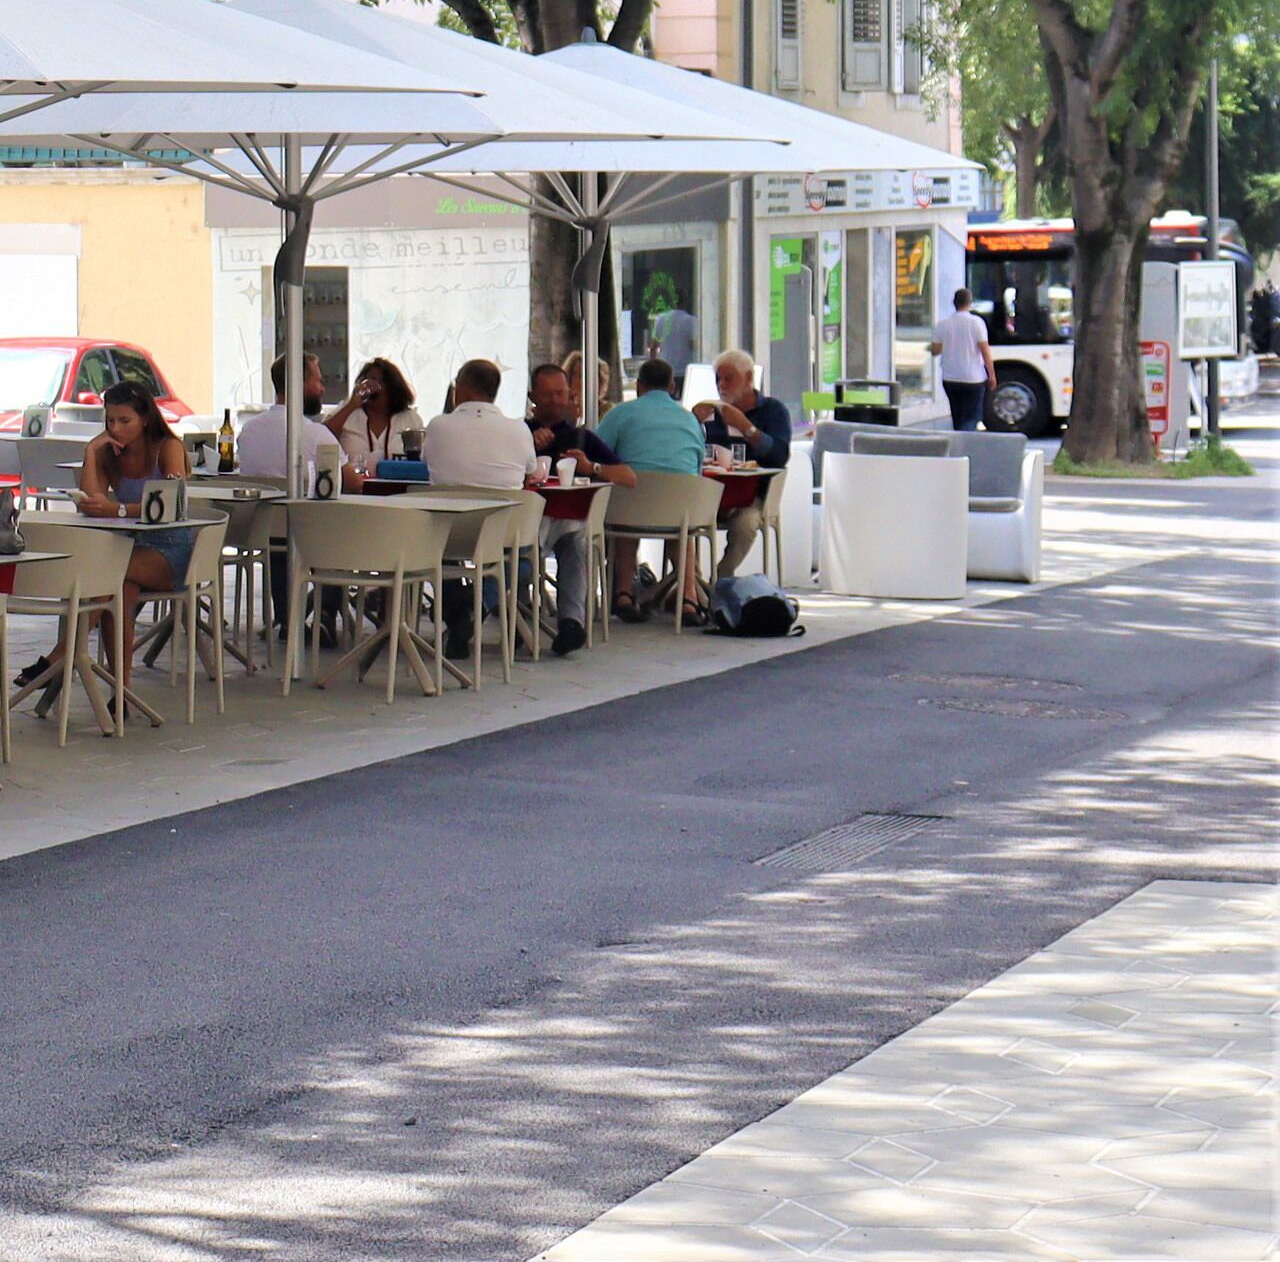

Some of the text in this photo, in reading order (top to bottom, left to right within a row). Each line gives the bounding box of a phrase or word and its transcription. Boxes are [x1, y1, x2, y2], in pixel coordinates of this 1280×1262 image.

[230, 235, 528, 264] un onde meilleu
